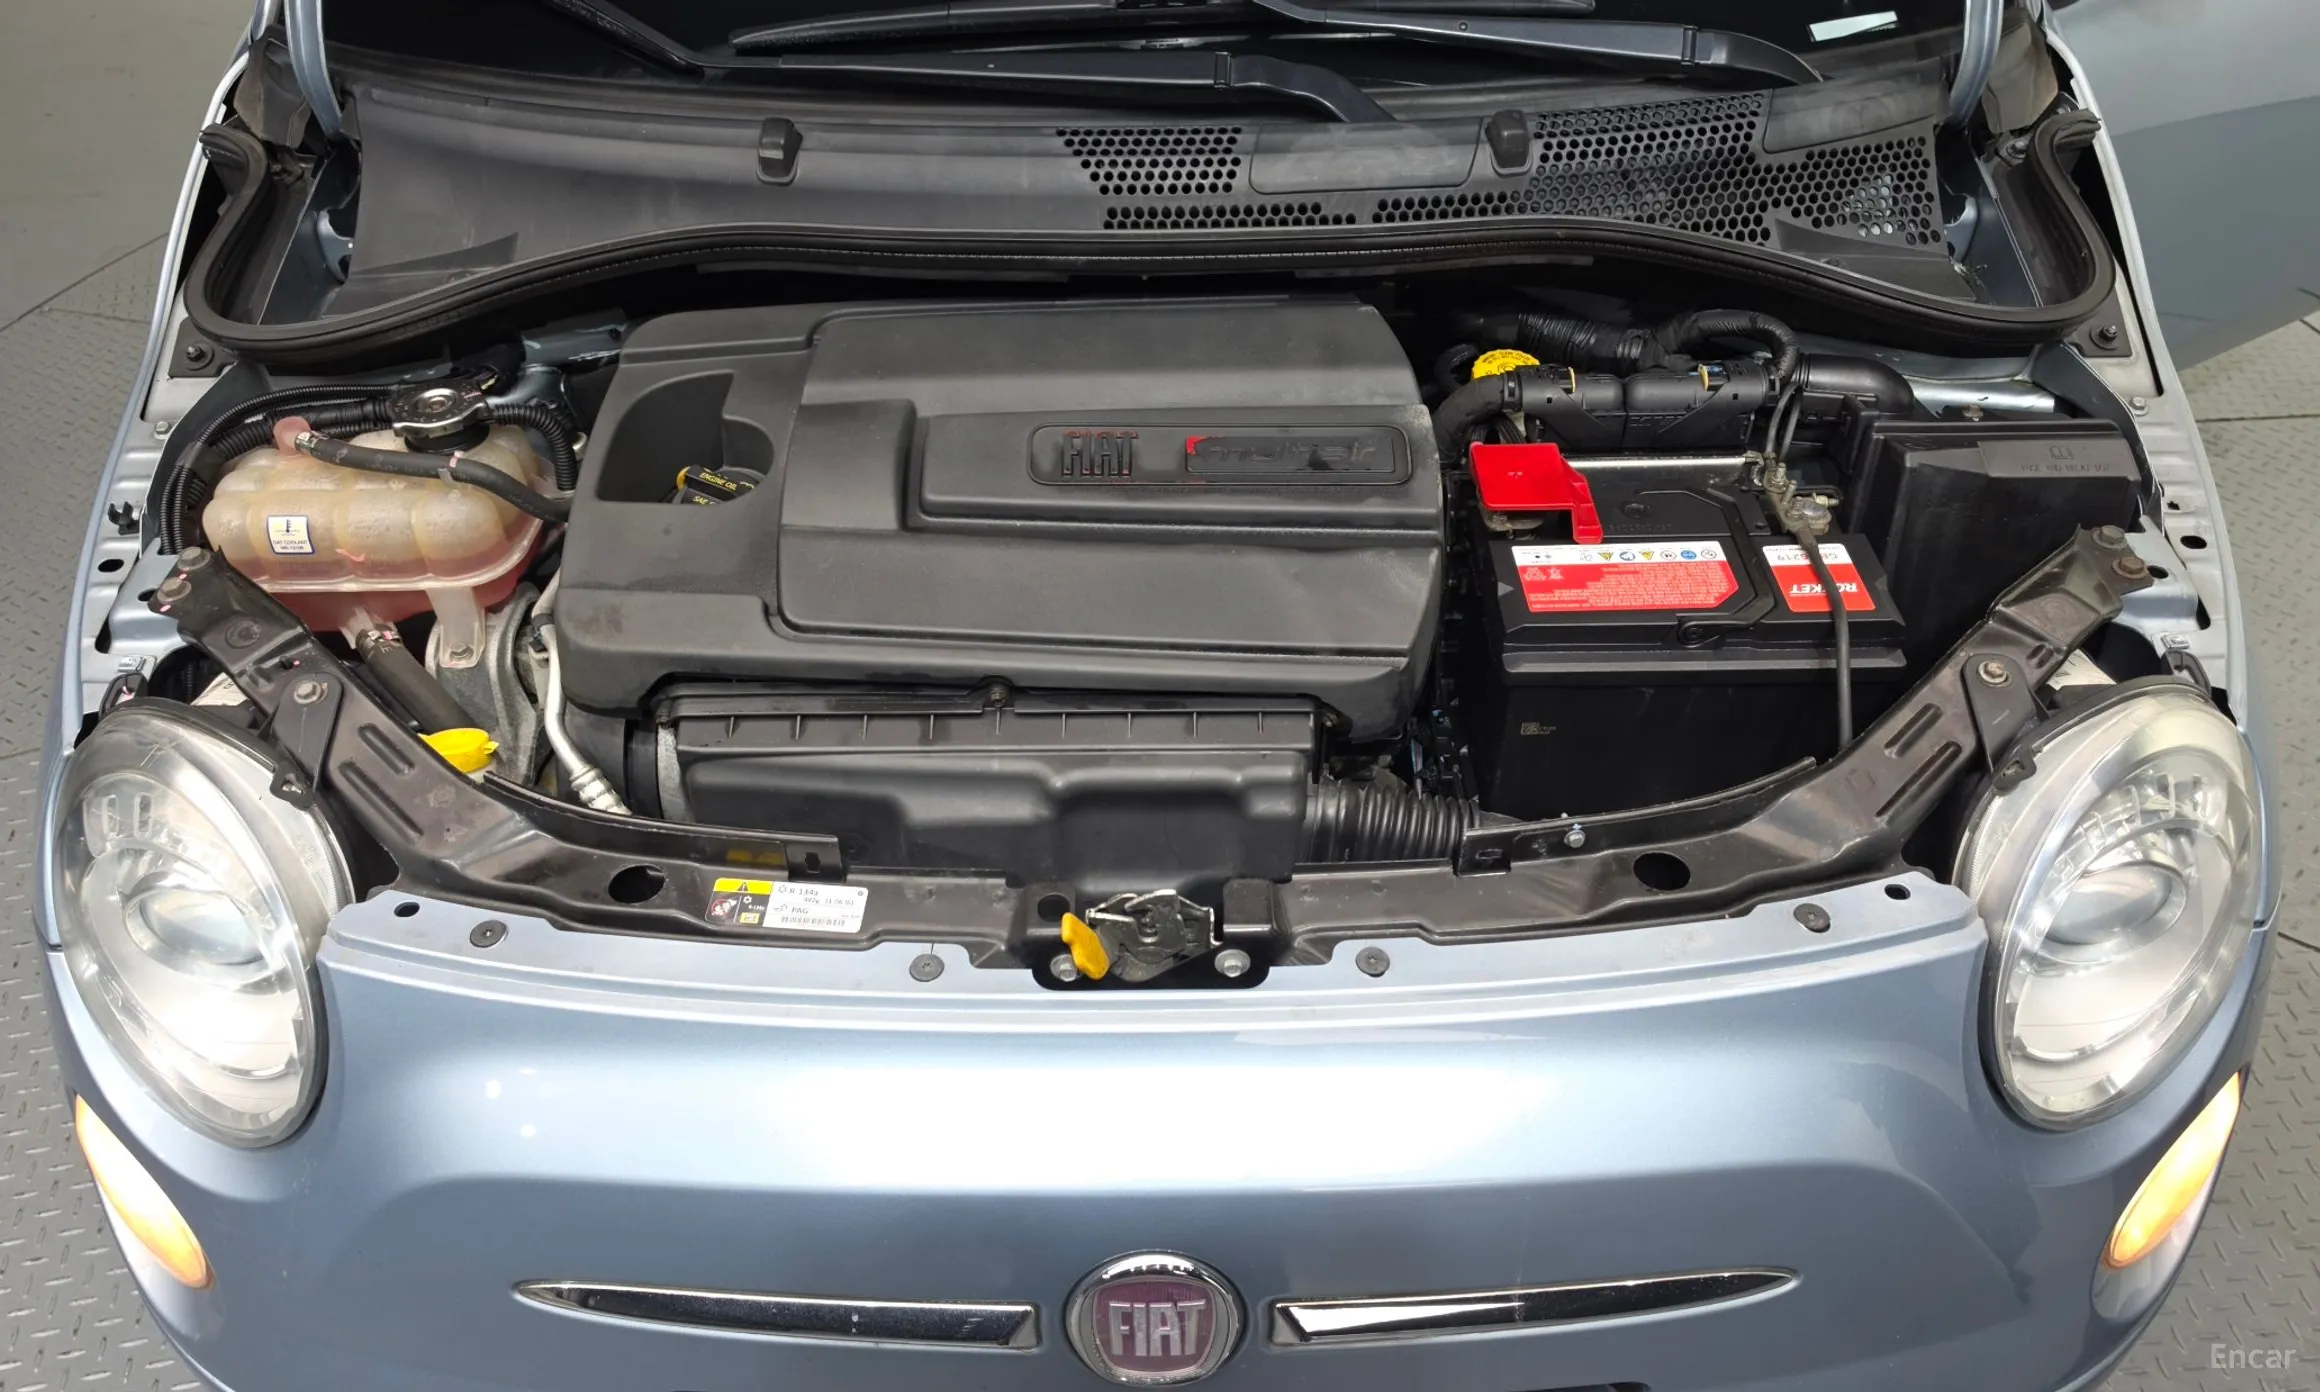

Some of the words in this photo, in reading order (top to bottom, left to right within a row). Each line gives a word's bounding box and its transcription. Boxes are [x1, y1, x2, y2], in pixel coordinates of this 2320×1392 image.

[1061, 430, 1139, 477] FIAT
[700, 472, 726, 486] ENGINE
[725, 482, 738, 491] OIL
[1789, 582, 1858, 595] ROKET
[1109, 1299, 1206, 1357] FIAT
